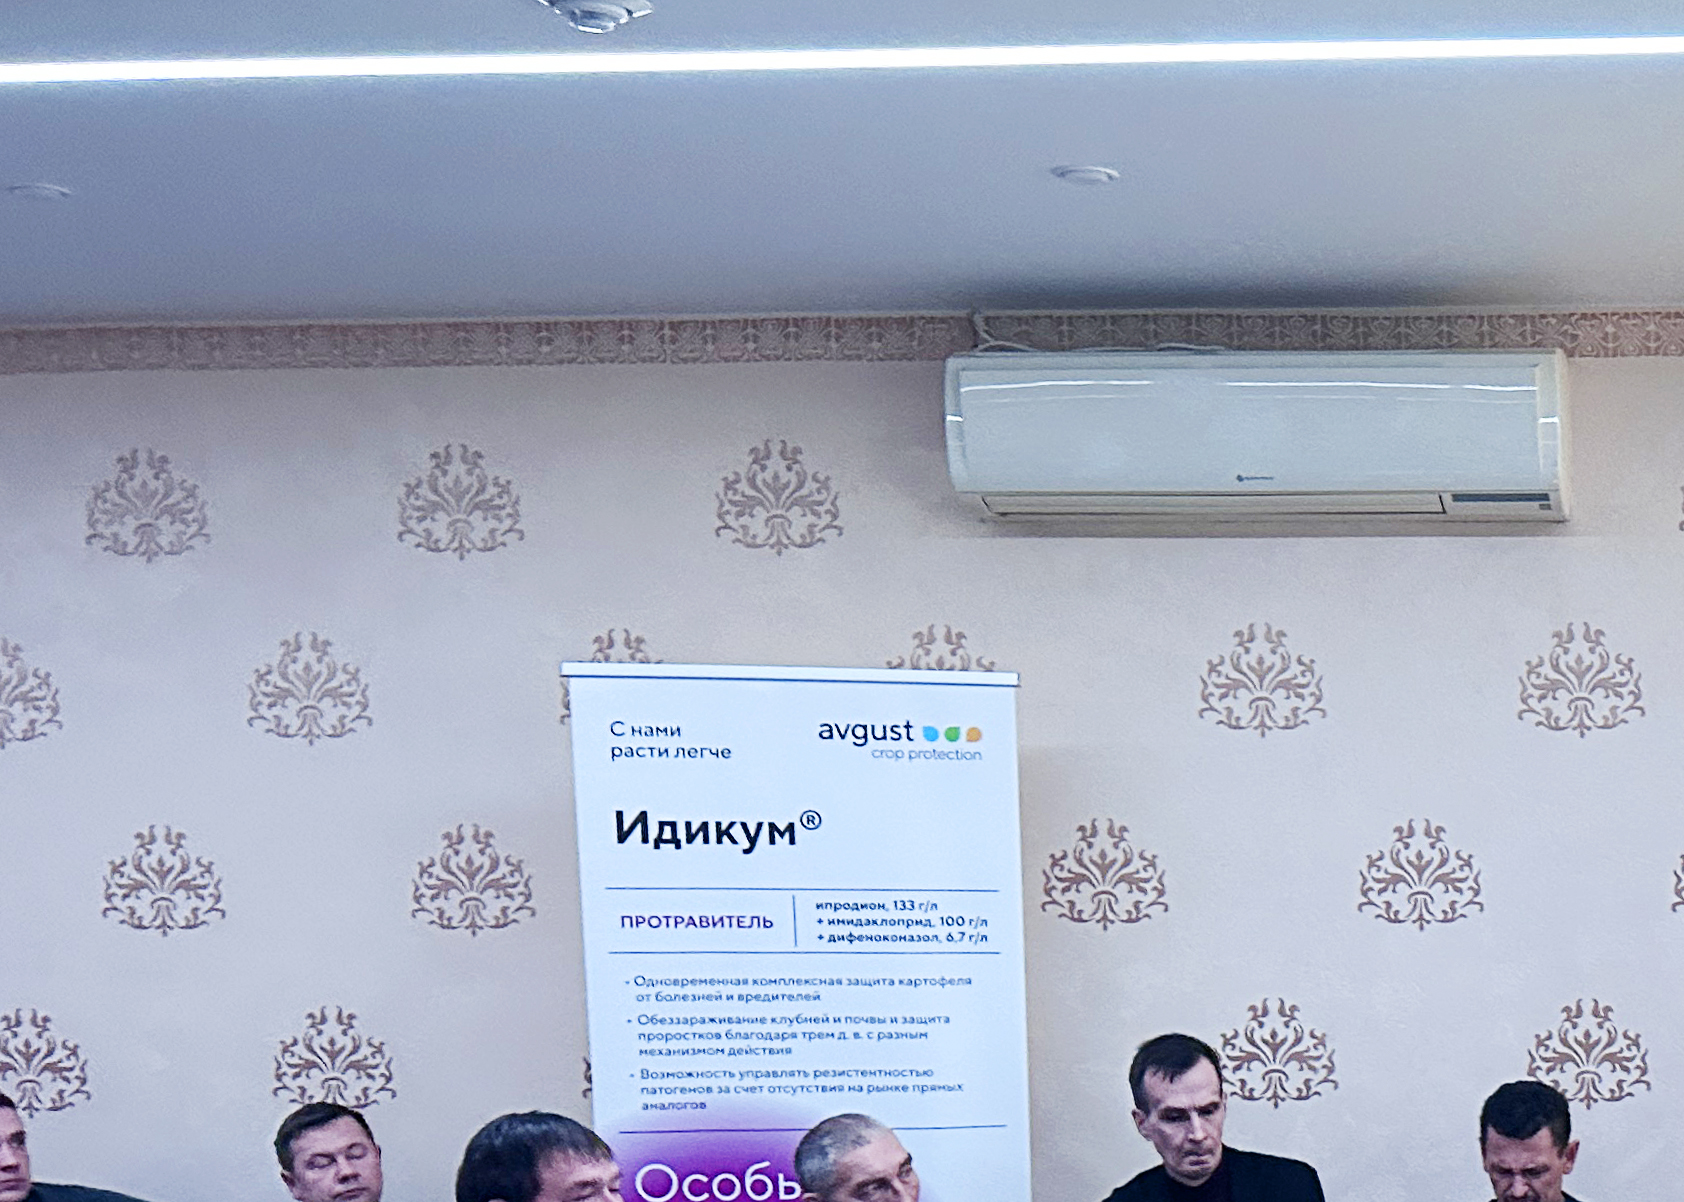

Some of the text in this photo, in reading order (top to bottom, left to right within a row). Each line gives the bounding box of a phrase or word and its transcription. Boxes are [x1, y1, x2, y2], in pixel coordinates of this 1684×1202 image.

[610, 720, 681, 738] С нами
[818, 719, 915, 747] avgust
[611, 746, 732, 762] расти легче
[871, 748, 983, 762] crop protection
[815, 900, 939, 913] ипродион, 133 г/л
[620, 914, 775, 931] ПРОТРАВИТЕЛЬ
[827, 916, 936, 929] имидаклоприд,
[939, 915, 966, 927] 100
[969, 916, 988, 929] г/л
[827, 932, 943, 944] дифеноконазол,
[969, 932, 988, 945] г/л
[634, 975, 973, 989] Одновременная комплексная защита картофеля
[636, 990, 822, 1004] от болезней и вредителей
[637, 1012, 951, 1027] Обеззараживание клубней и почвы и защита
[638, 1031, 722, 1043] проростков
[725, 1029, 798, 1042] благодаря
[802, 1031, 835, 1042] трем
[866, 1031, 874, 1040] с
[877, 1031, 929, 1042] разным
[639, 1045, 793, 1057] механизмом действия
[640, 1068, 934, 1081] Возможность управлять резистентностью
[641, 1083, 965, 1096] патогенов за счет отсутствия на рынке прямых
[642, 1100, 707, 1111] аналогов
